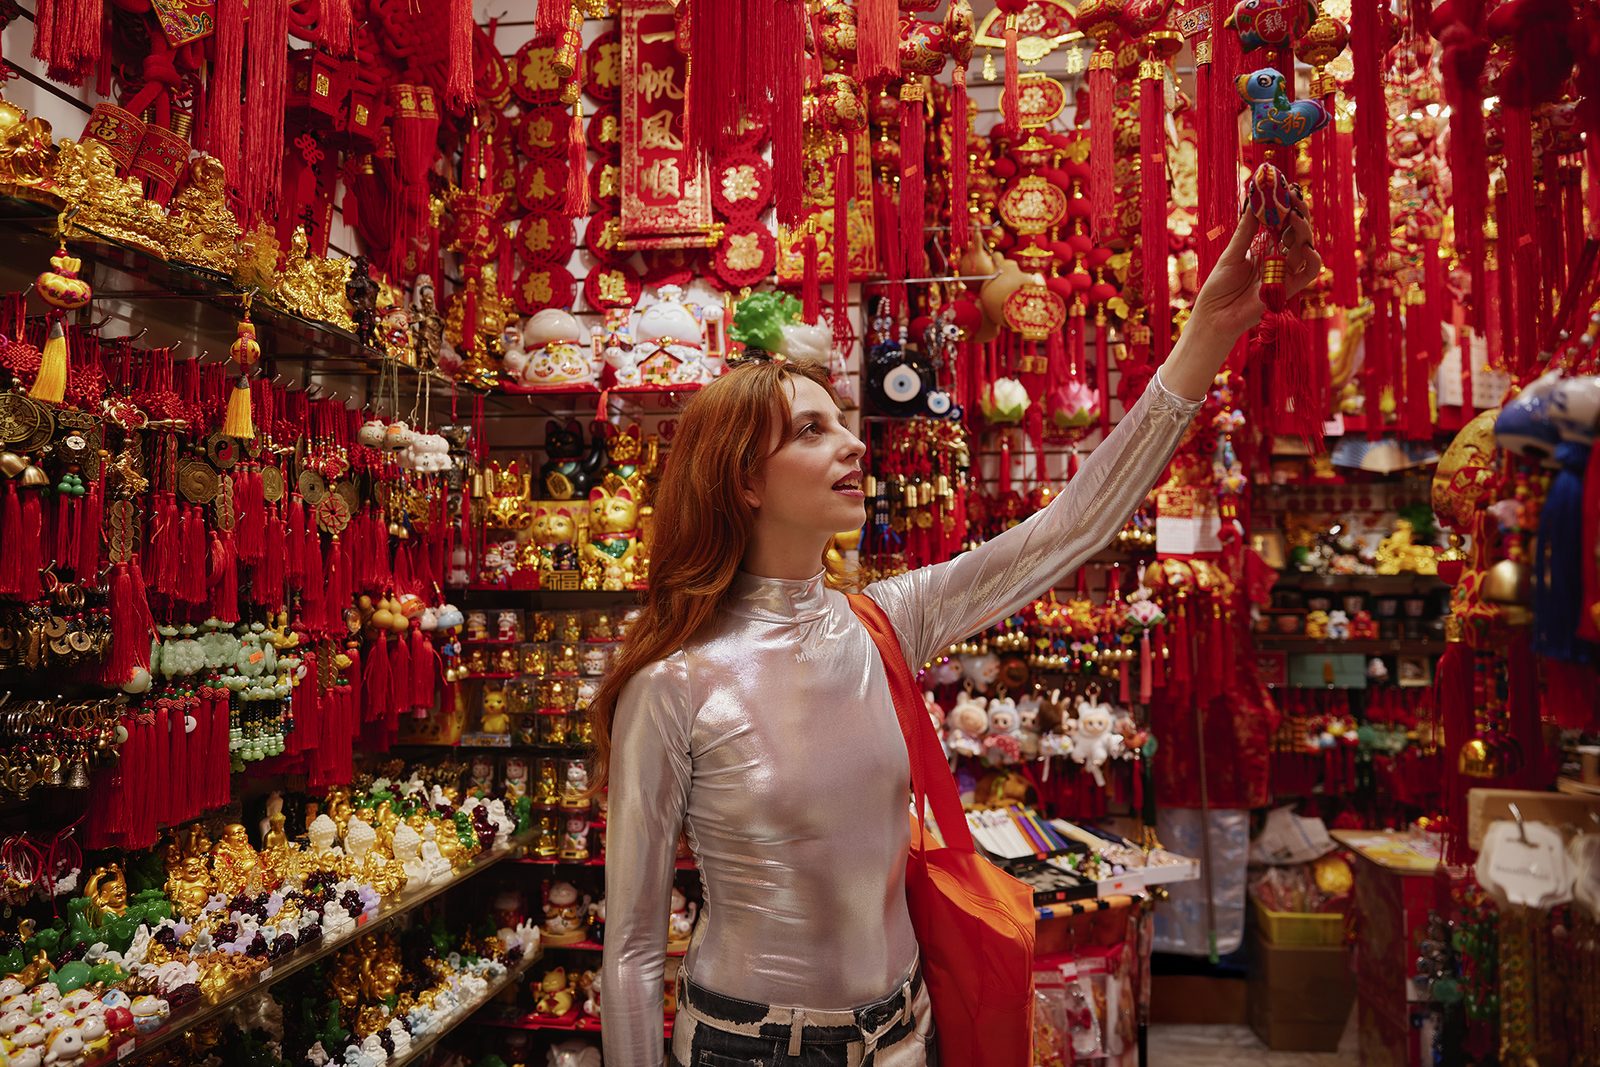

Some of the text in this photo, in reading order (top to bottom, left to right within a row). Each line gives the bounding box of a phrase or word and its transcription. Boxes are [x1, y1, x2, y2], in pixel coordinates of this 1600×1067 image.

[521, 46, 562, 92] 福
[90, 113, 120, 141] 福
[1280, 111, 1307, 135] 狗
[549, 571, 580, 591] 福
